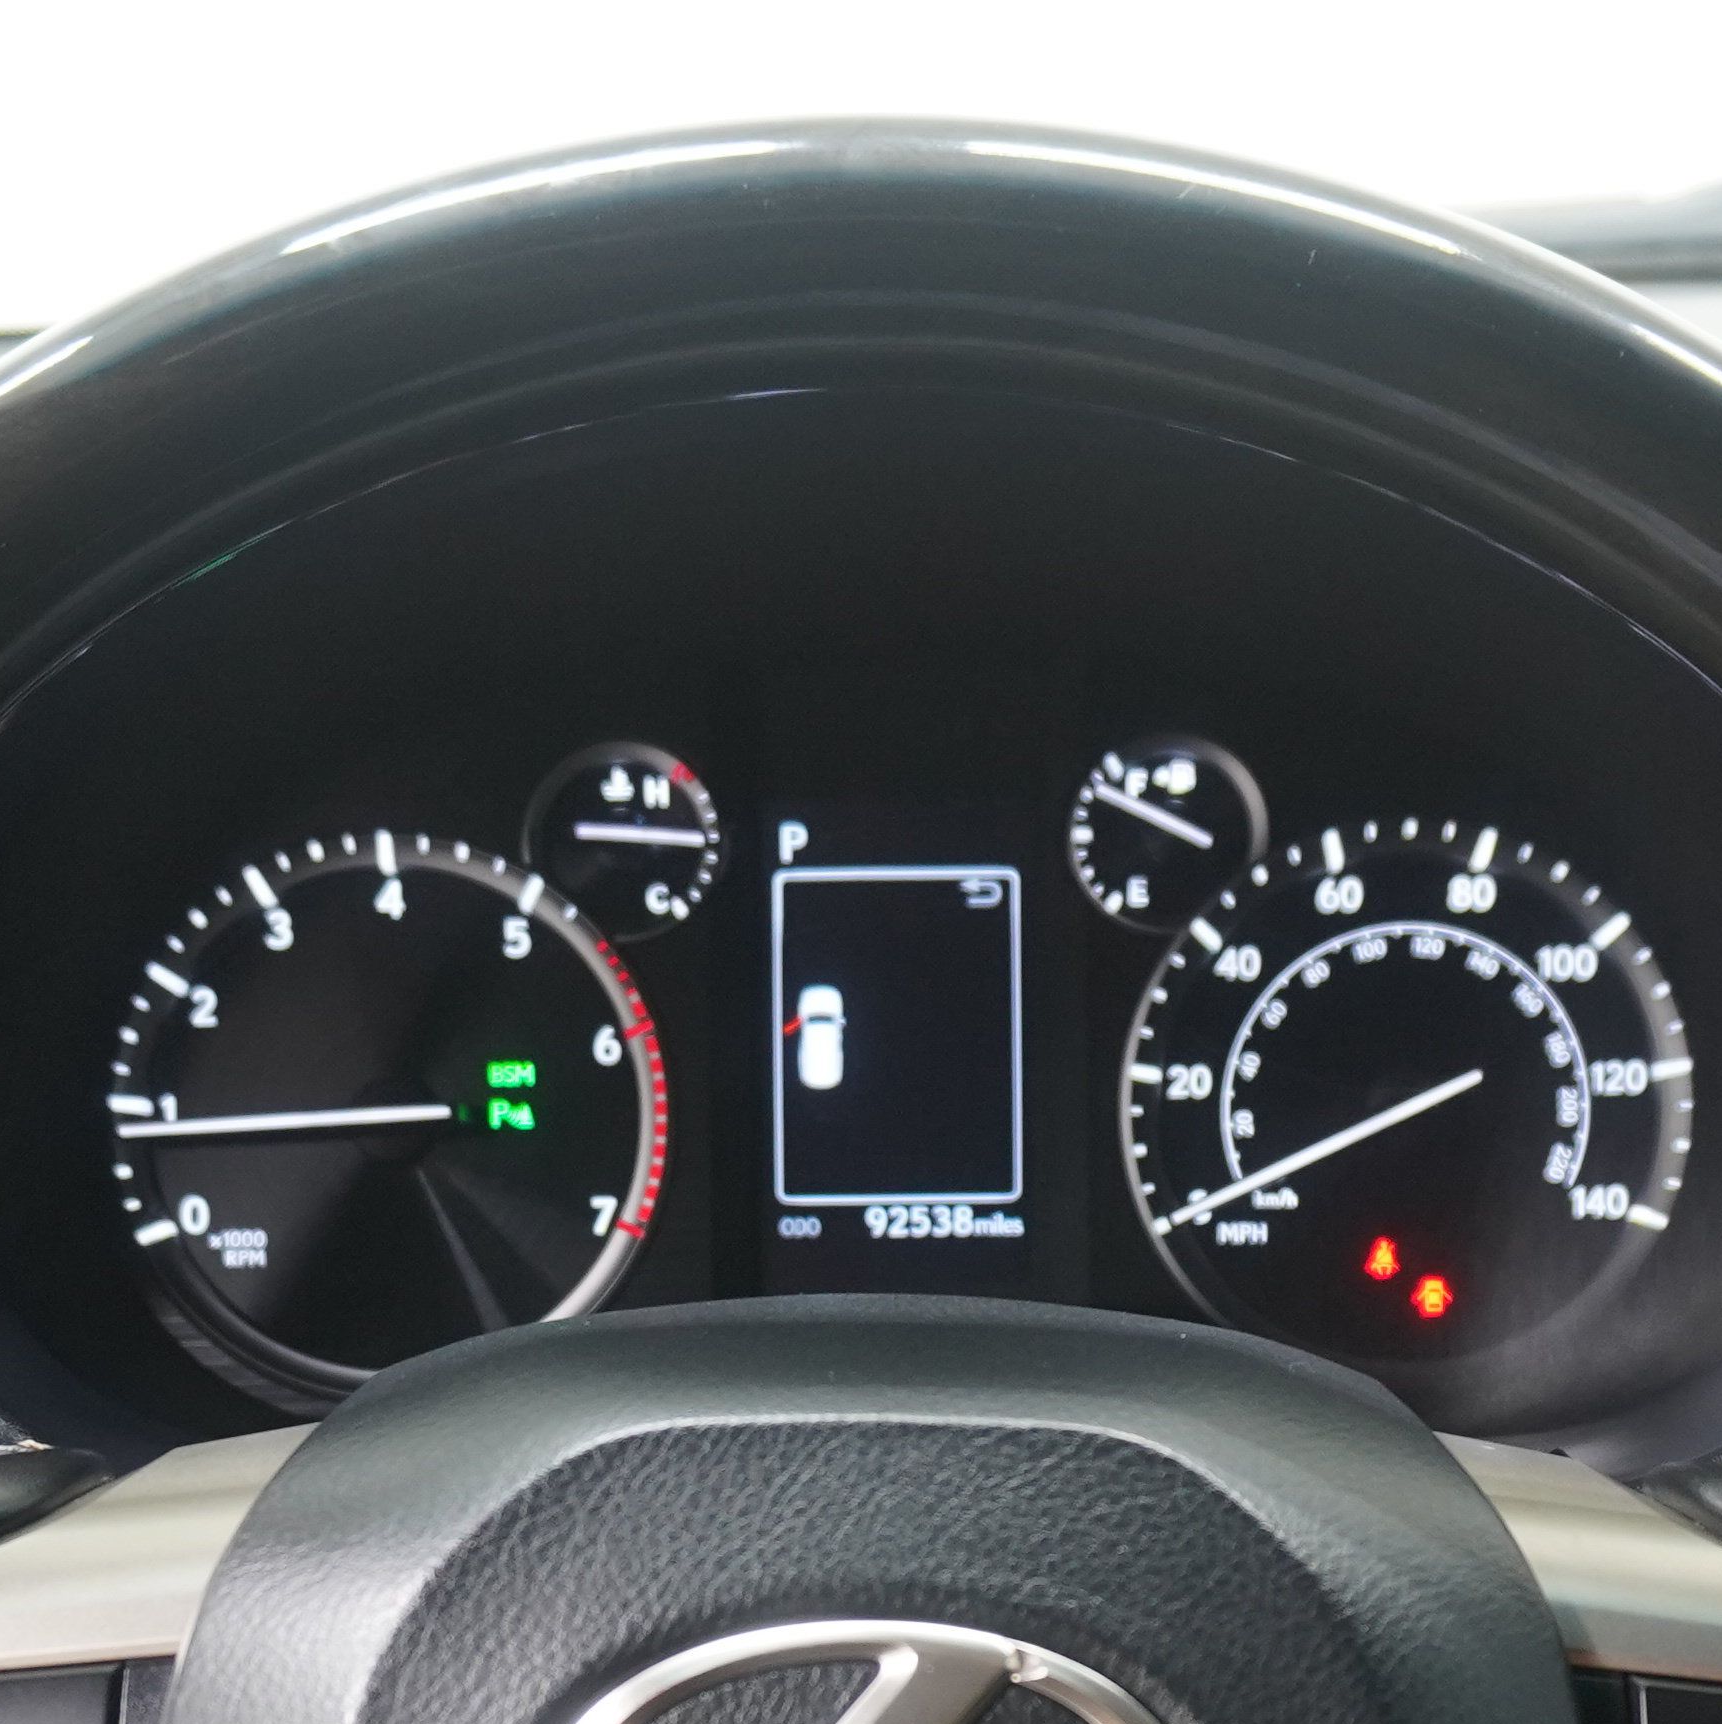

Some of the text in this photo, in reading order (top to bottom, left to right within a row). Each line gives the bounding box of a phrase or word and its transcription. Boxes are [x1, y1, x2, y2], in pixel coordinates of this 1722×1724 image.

[643, 777, 671, 808] H
[1125, 767, 1149, 799] F
[779, 820, 809, 866] P
[375, 877, 406, 919] 4
[644, 884, 670, 915] C
[1126, 874, 1151, 909] E
[1314, 874, 1365, 915] 60
[1446, 873, 1498, 913] 80
[264, 908, 293, 950] 3
[502, 918, 533, 959] 5
[1410, 935, 1446, 960] 120
[1212, 944, 1262, 982] 40
[1351, 937, 1388, 963] 100
[1464, 948, 1501, 981] 140
[1535, 943, 1599, 983] 100
[1300, 958, 1331, 989] 80
[190, 986, 219, 1027] 2
[1259, 997, 1288, 1030] 60
[1511, 981, 1544, 1018] 160
[592, 1025, 622, 1065] 6
[1542, 1030, 1571, 1069] 180
[486, 1059, 537, 1088] BSM
[1165, 1062, 1214, 1100] 20
[1237, 1050, 1262, 1083] 40
[1587, 1057, 1649, 1096] 120
[161, 1094, 179, 1123] 1
[1232, 1108, 1256, 1139] 20
[1554, 1084, 1578, 1128] 200
[1542, 1142, 1572, 1185] 220
[178, 1194, 211, 1236] 0
[589, 1195, 618, 1235] 7
[1251, 1186, 1300, 1210] km/h
[1569, 1183, 1630, 1220] 140
[1215, 1220, 1269, 1246] MPH
[222, 1249, 268, 1269] RPM
